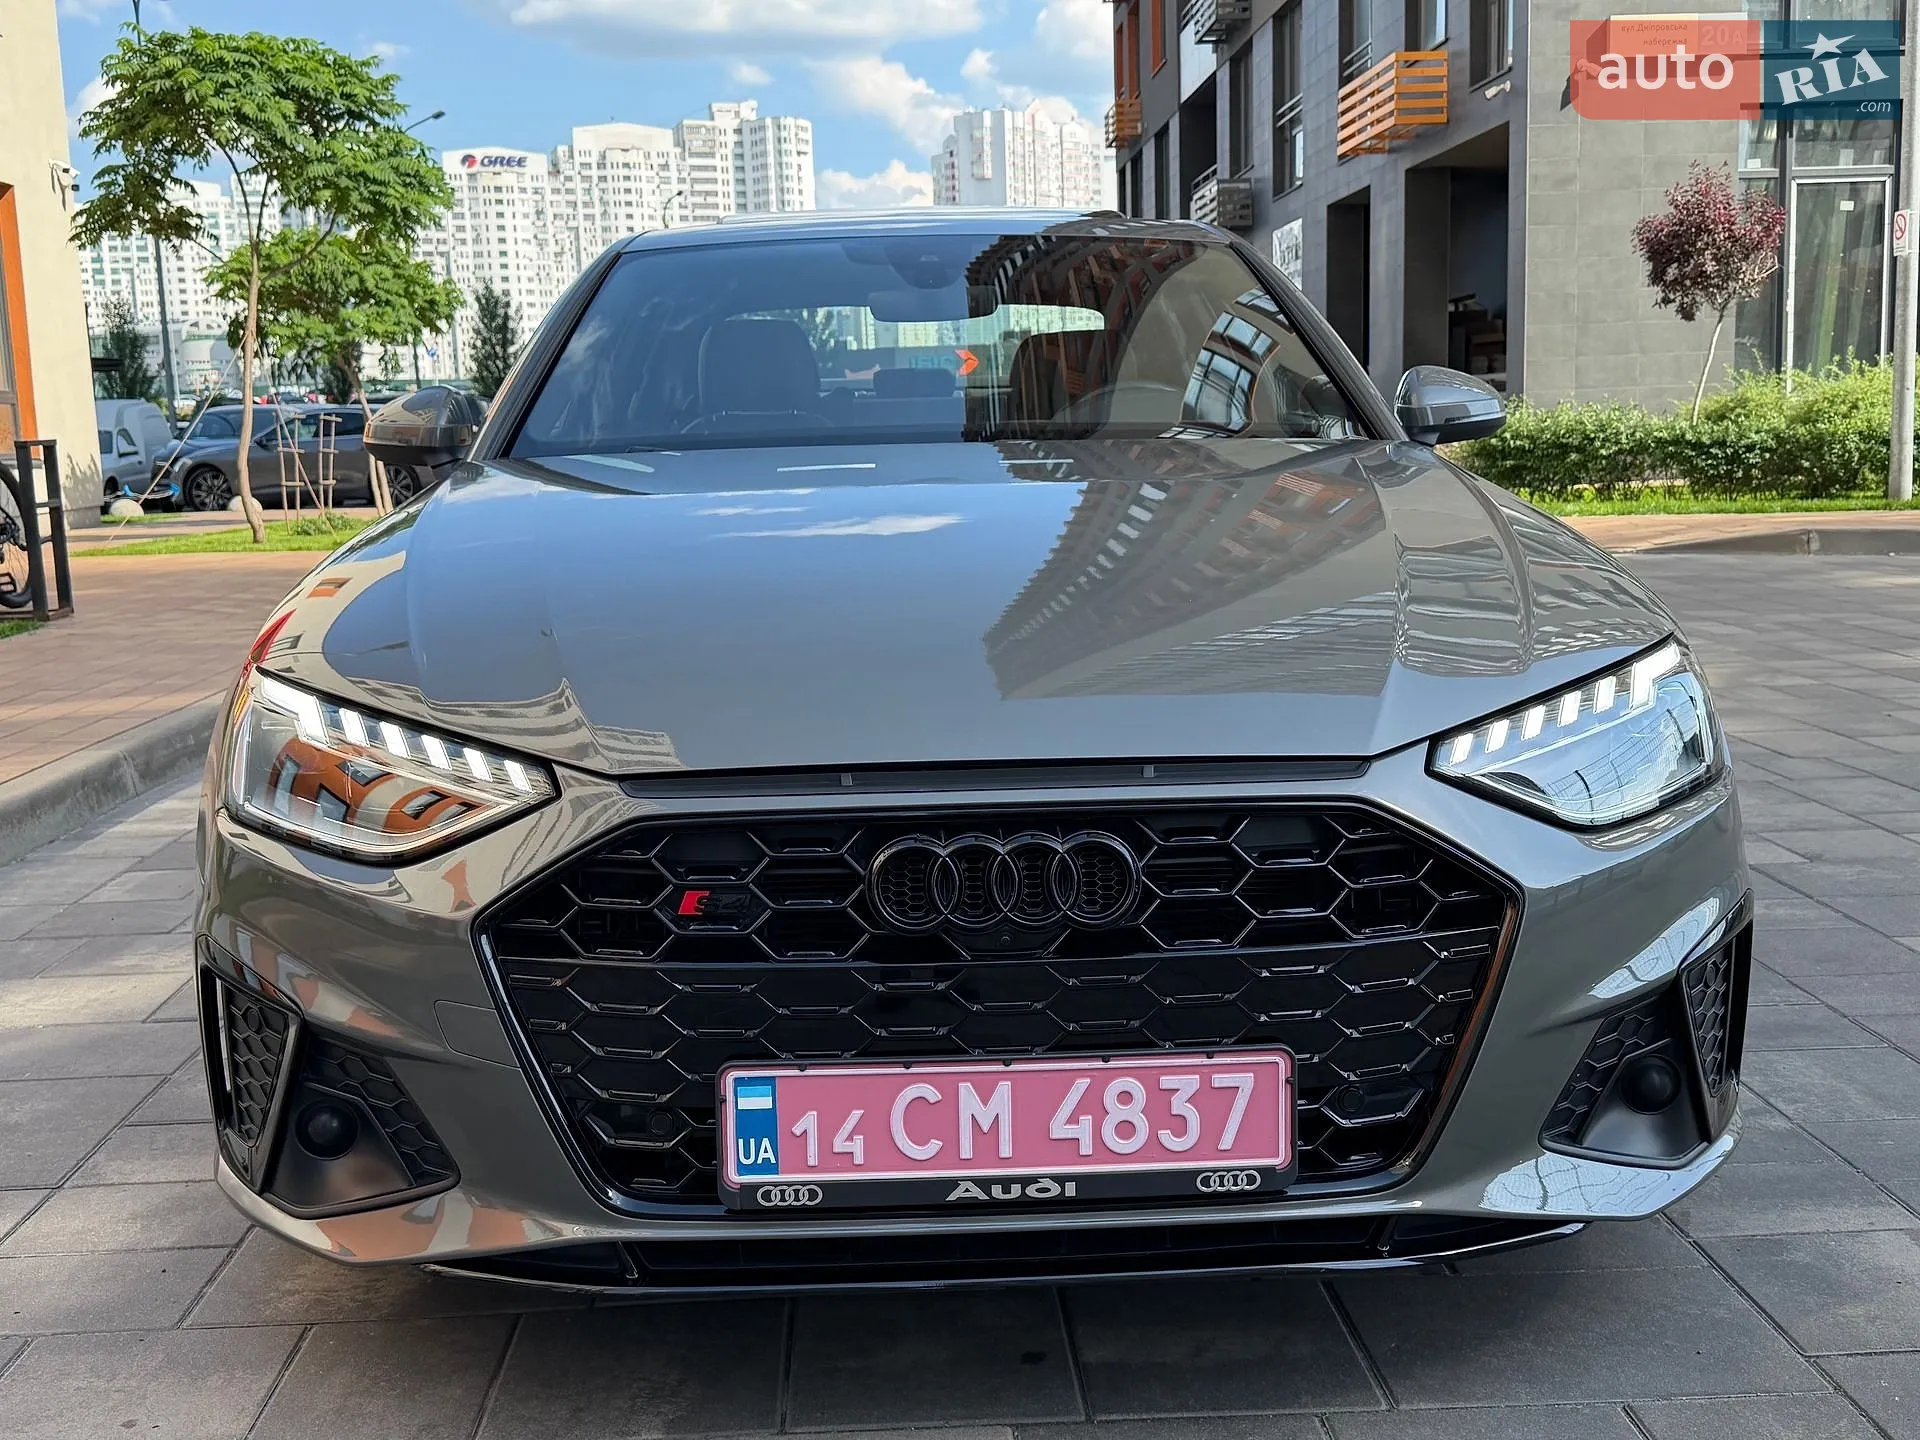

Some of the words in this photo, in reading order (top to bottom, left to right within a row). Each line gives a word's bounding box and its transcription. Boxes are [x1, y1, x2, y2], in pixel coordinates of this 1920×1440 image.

[480, 155, 528, 168] GREE
[791, 1109, 864, 1167] 14
[890, 1081, 1012, 1161] CM
[1050, 1072, 1255, 1156] 4837
[738, 1137, 776, 1165] UA
[945, 1177, 1077, 1200] Audi
